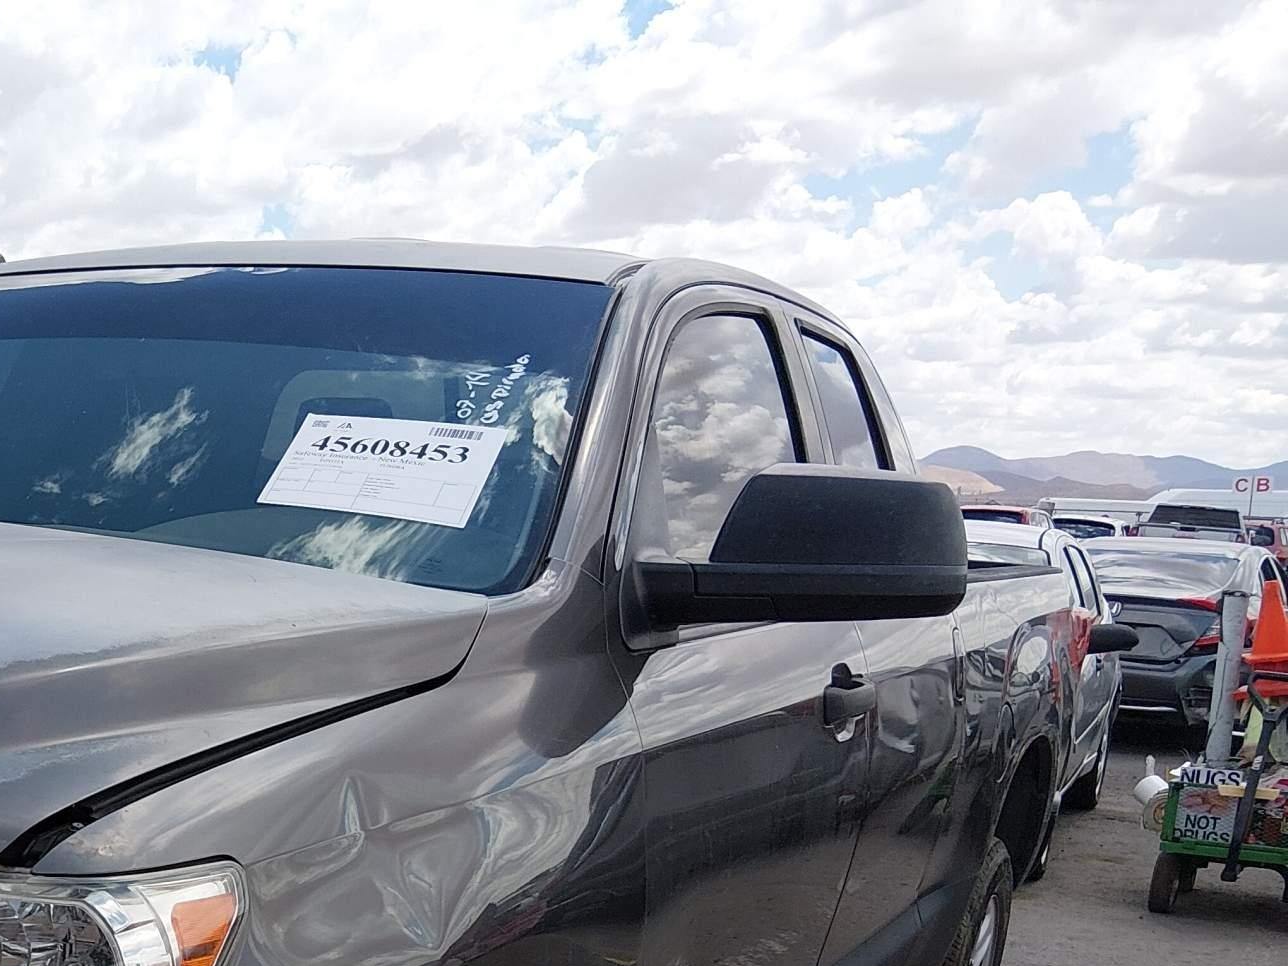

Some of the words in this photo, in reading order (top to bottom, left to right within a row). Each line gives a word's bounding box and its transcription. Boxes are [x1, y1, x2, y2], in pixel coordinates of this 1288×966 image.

[311, 435, 470, 464] 45608453
[1235, 478, 1249, 493] C
[1256, 477, 1270, 492] B
[1180, 768, 1241, 786] NUGS
[1184, 814, 1221, 830] NOT
